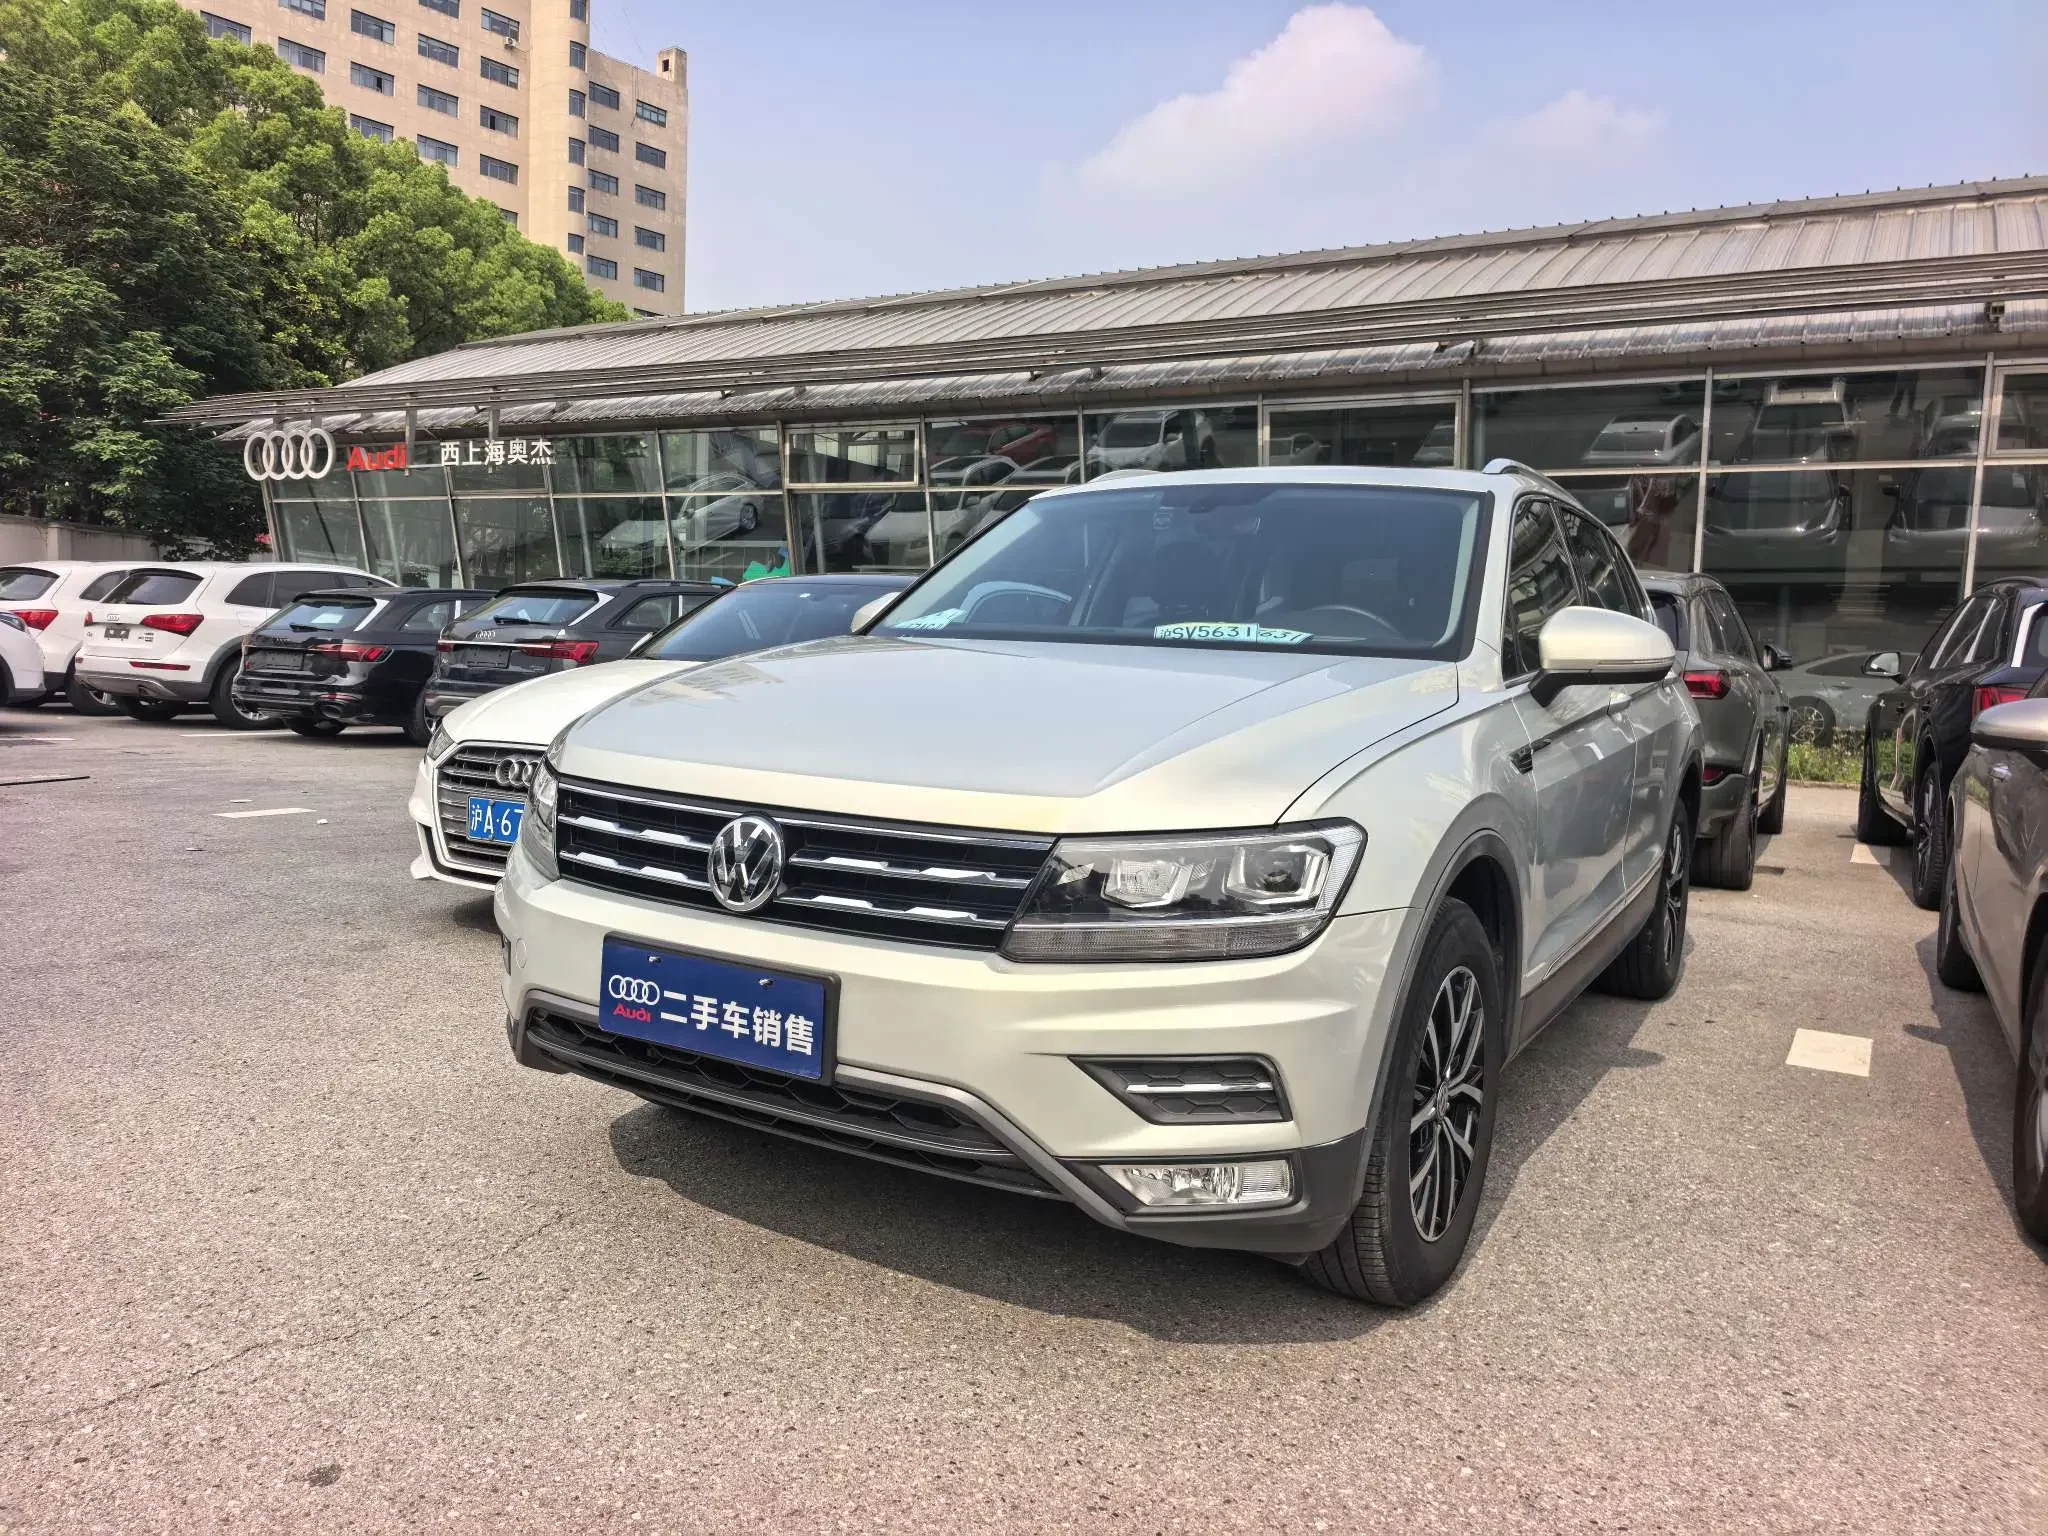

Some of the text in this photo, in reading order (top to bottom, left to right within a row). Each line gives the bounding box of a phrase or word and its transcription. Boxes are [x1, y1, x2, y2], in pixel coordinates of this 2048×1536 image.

[346, 443, 408, 471] Audi
[440, 438, 555, 467] 西上海奥杰
[612, 1003, 653, 1023] Audi
[660, 990, 815, 1056] 二手车销售
